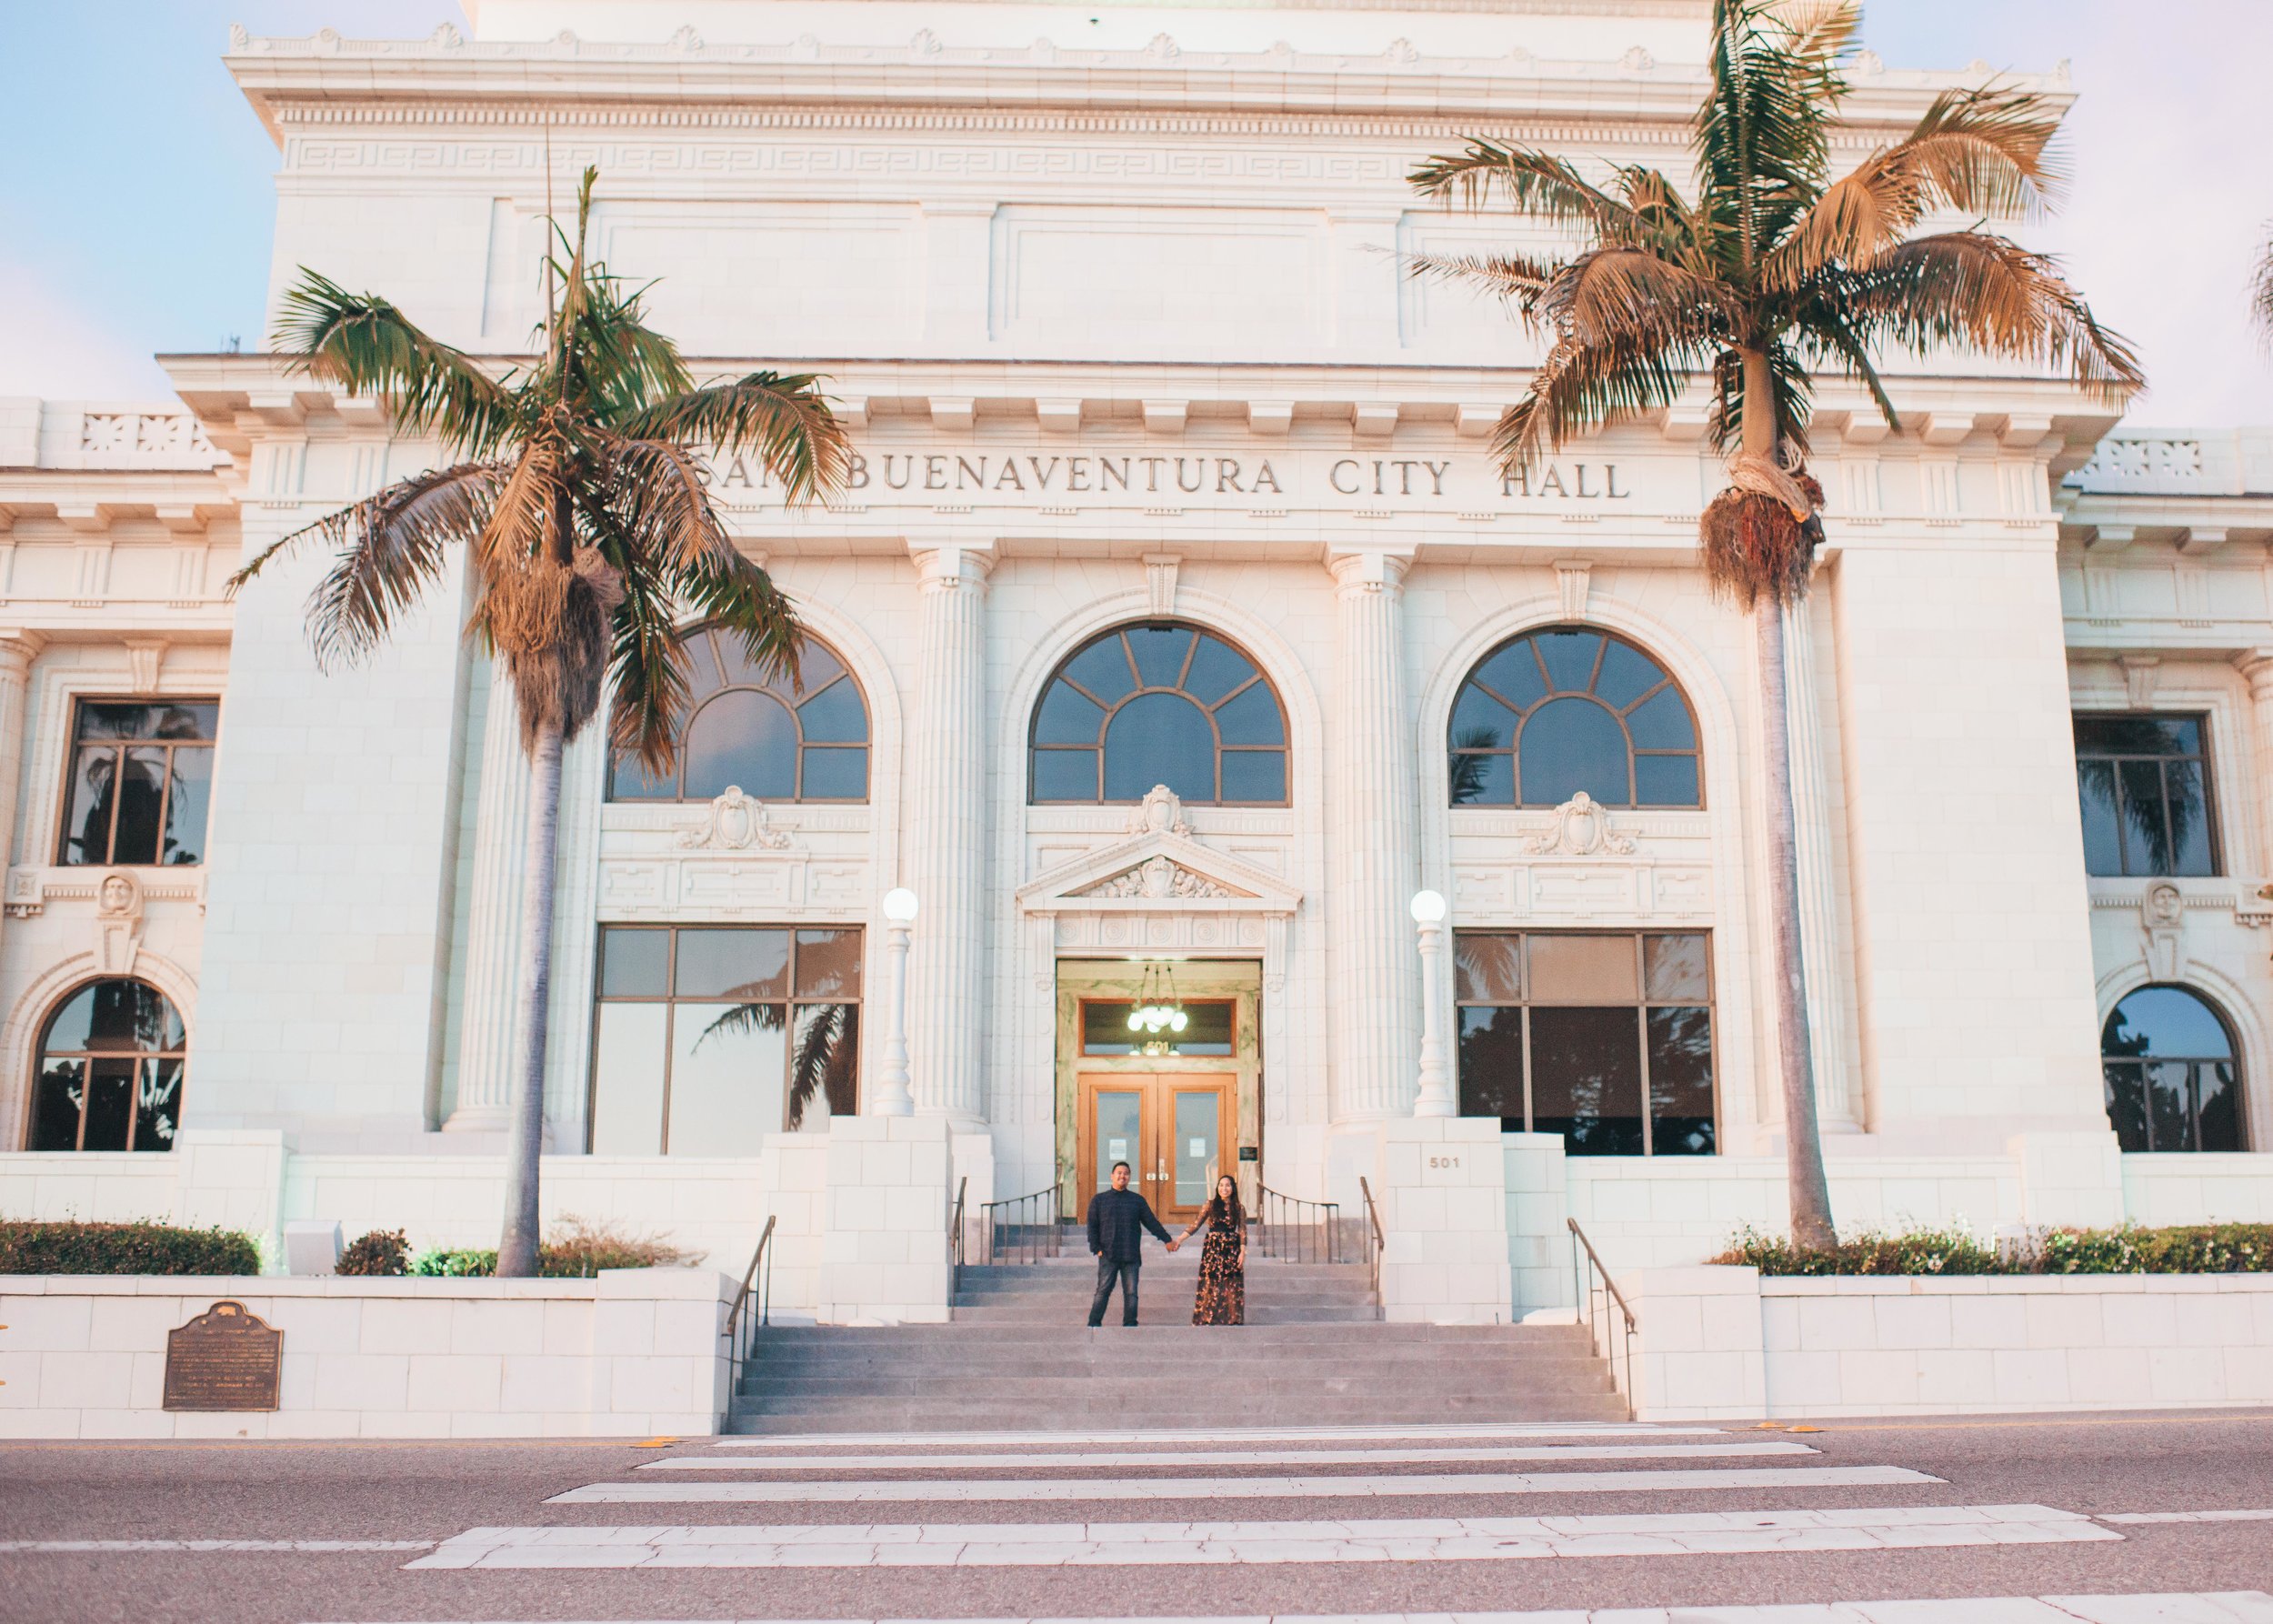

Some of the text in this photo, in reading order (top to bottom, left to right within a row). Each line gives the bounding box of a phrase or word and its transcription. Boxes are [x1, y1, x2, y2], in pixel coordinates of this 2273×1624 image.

[846, 454, 1283, 494] BUENAVENTURA
[1329, 458, 1451, 496] CITY
[1500, 462, 1630, 498] HALL
[1429, 1157, 1460, 1168] 501
